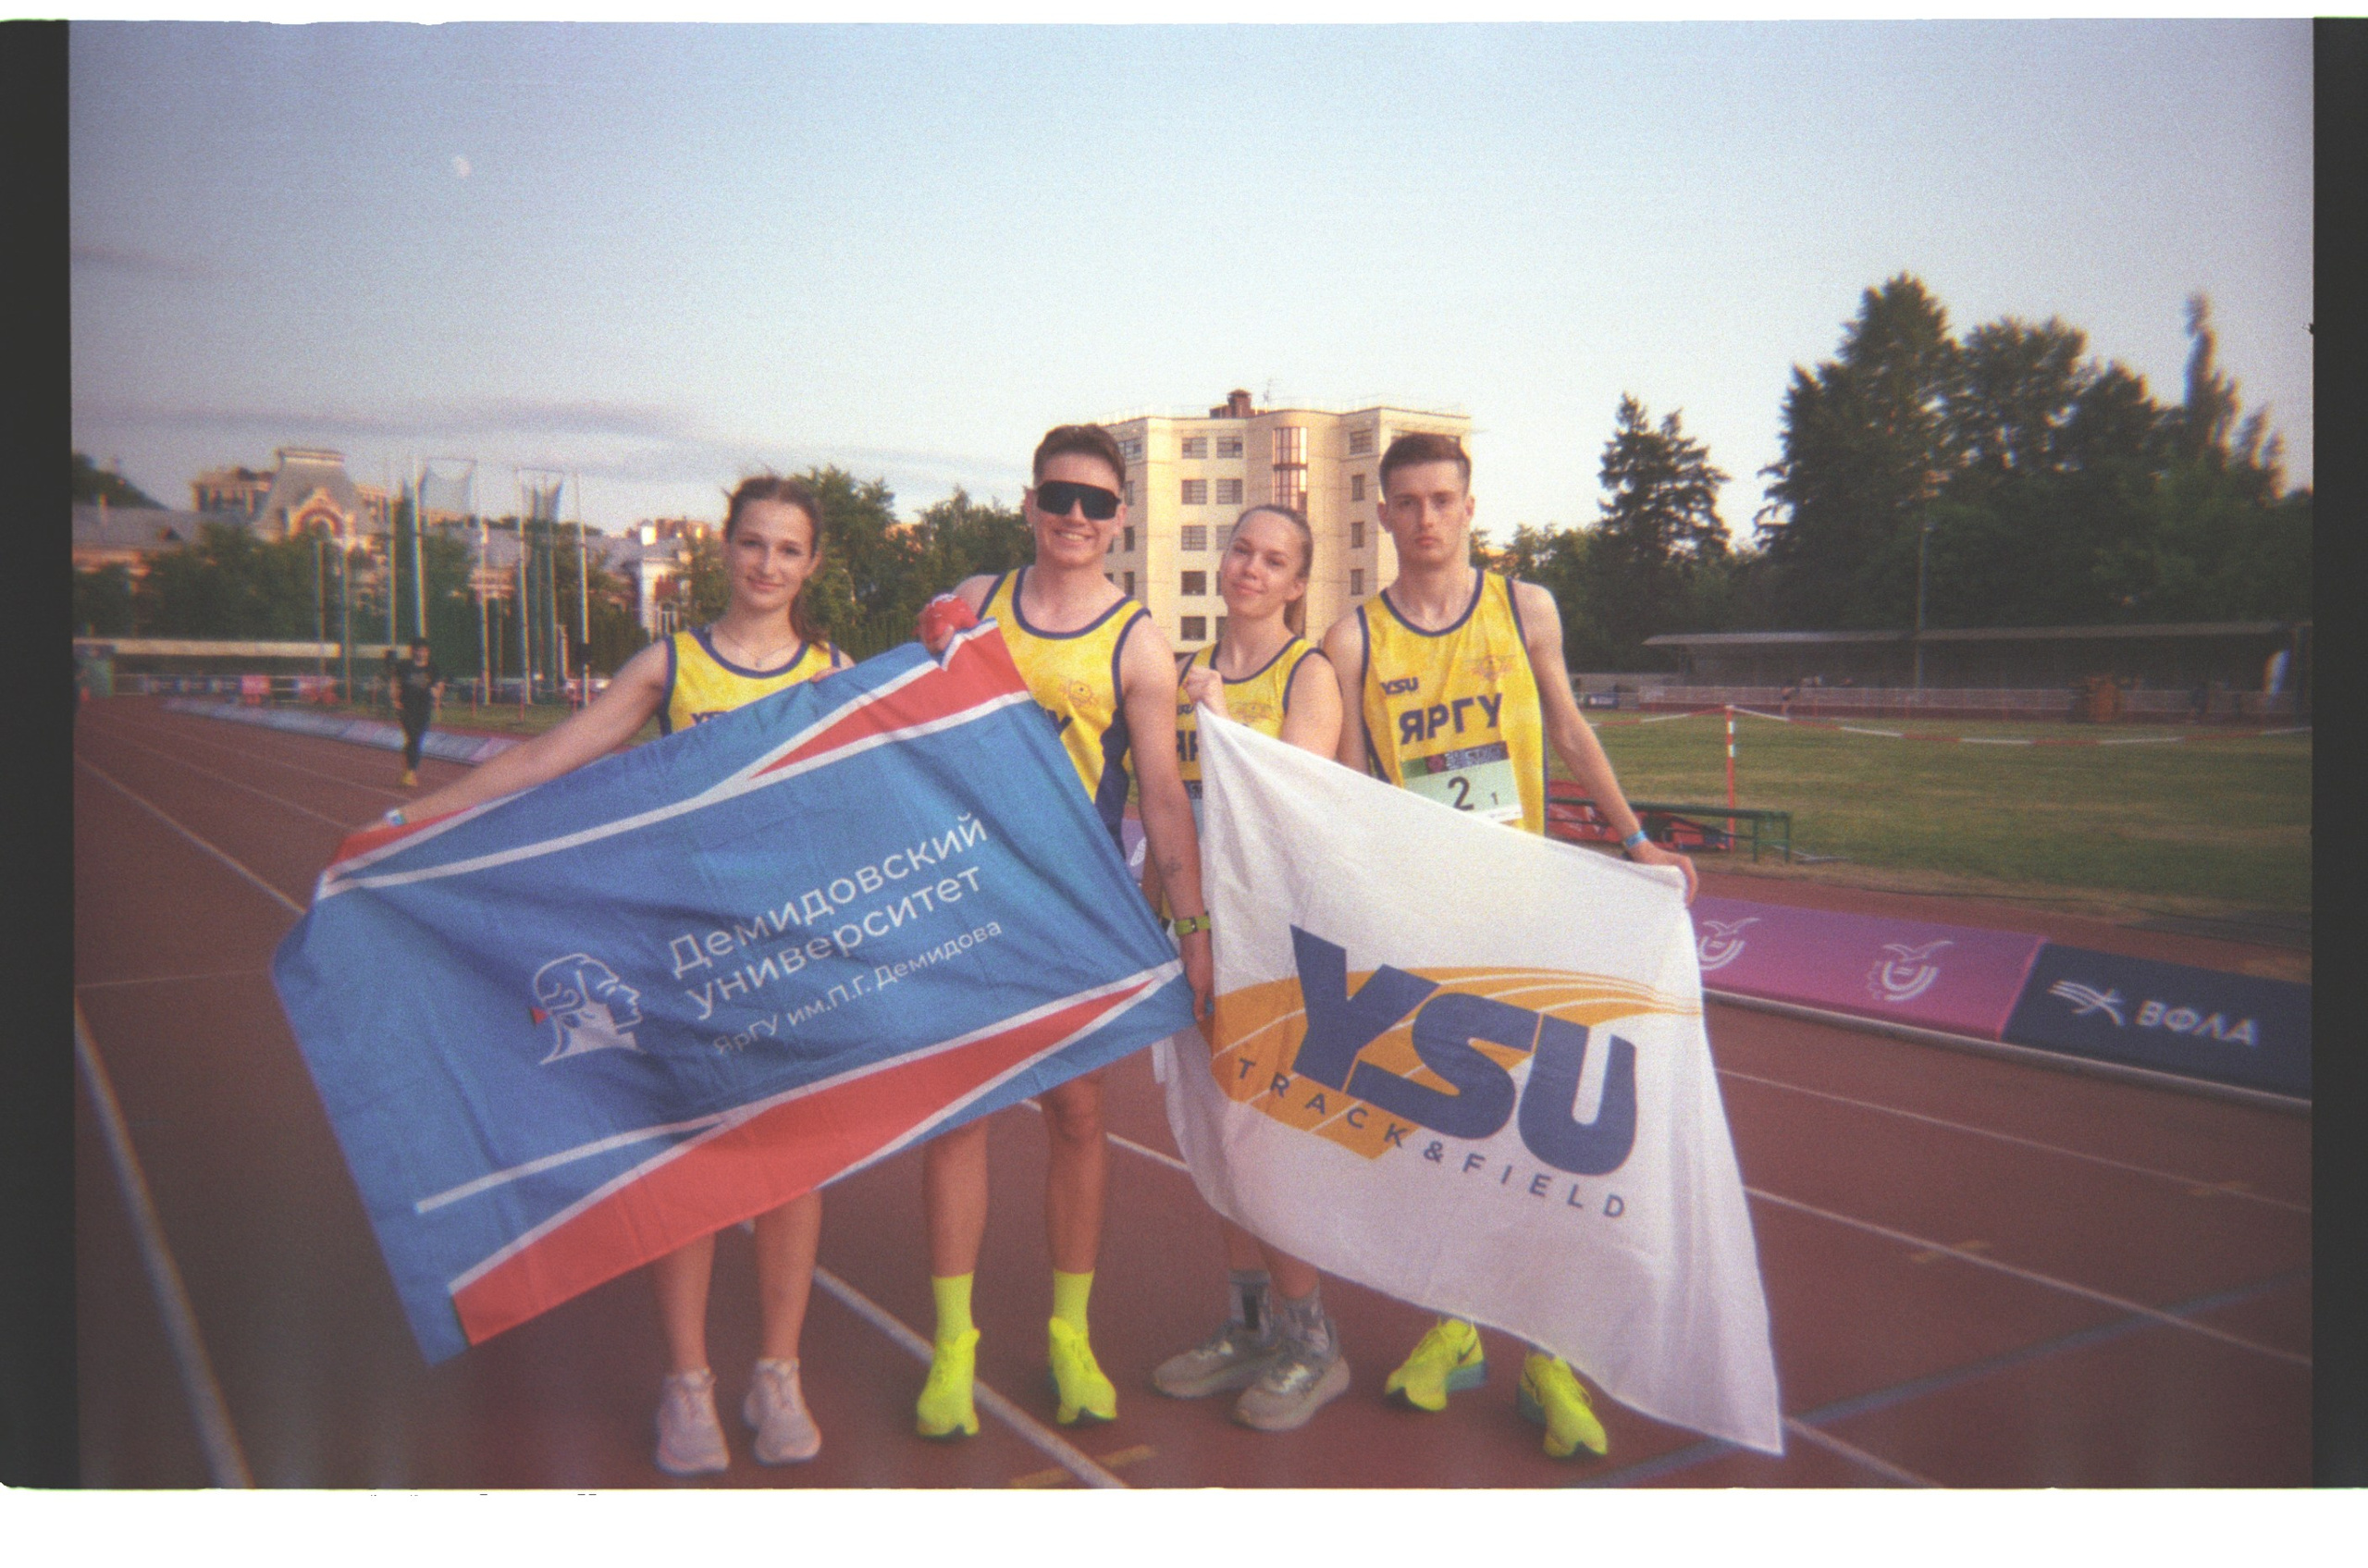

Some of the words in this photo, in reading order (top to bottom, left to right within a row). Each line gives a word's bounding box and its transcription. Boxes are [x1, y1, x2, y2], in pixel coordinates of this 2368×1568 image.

[1399, 693, 1502, 746] ЯРГУ
[1448, 776, 1474, 810] 2
[1490, 792, 1498, 805] 1
[669, 812, 988, 979] Демидовский
[686, 866, 980, 1020] университет
[712, 1016, 782, 1056] ЯрГУ
[874, 920, 1003, 990] Демидова
[1289, 923, 1637, 1177] YSU
